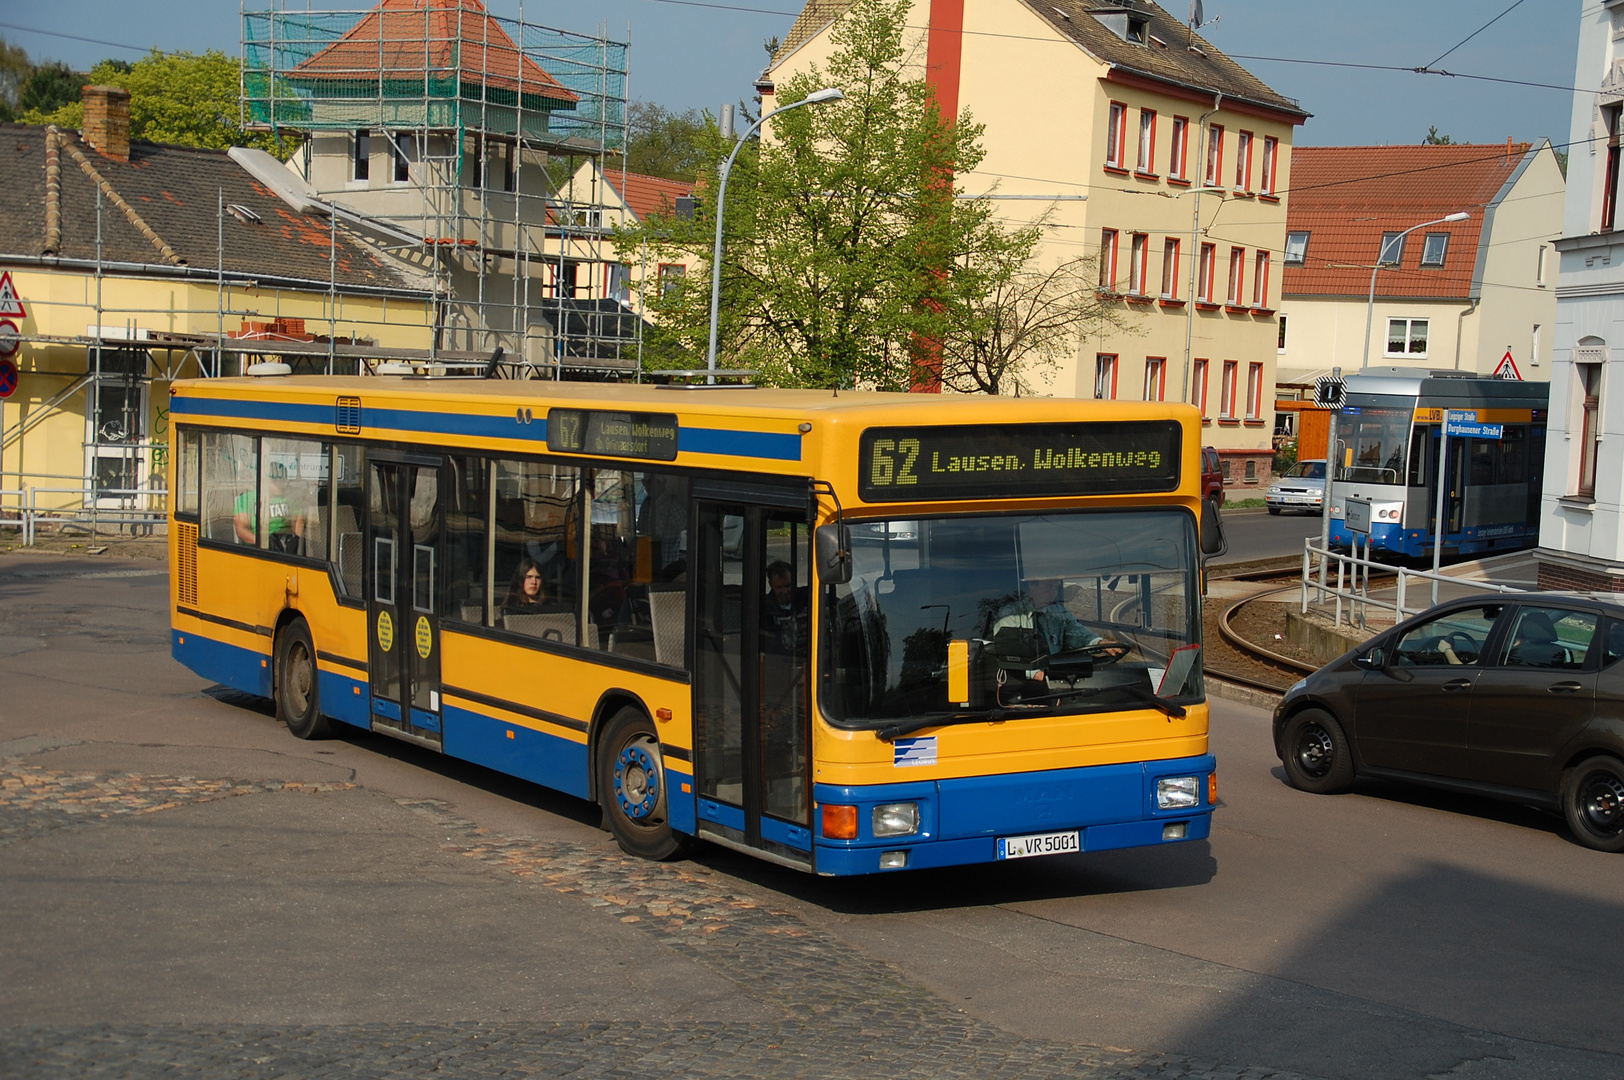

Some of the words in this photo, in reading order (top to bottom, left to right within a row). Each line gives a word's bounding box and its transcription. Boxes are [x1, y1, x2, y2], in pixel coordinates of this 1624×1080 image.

[1464, 412, 1476, 421] Straße
[559, 415, 580, 448] 62
[631, 423, 675, 440] Wolkenweg
[1447, 423, 1481, 435] Burghausener
[1482, 425, 1500, 436] Straße
[871, 438, 920, 486] 62
[1033, 448, 1161, 470] Wolkenweg
[1007, 841, 1016, 856] L
[1025, 838, 1042, 854] VR
[1045, 834, 1077, 852] 5001
